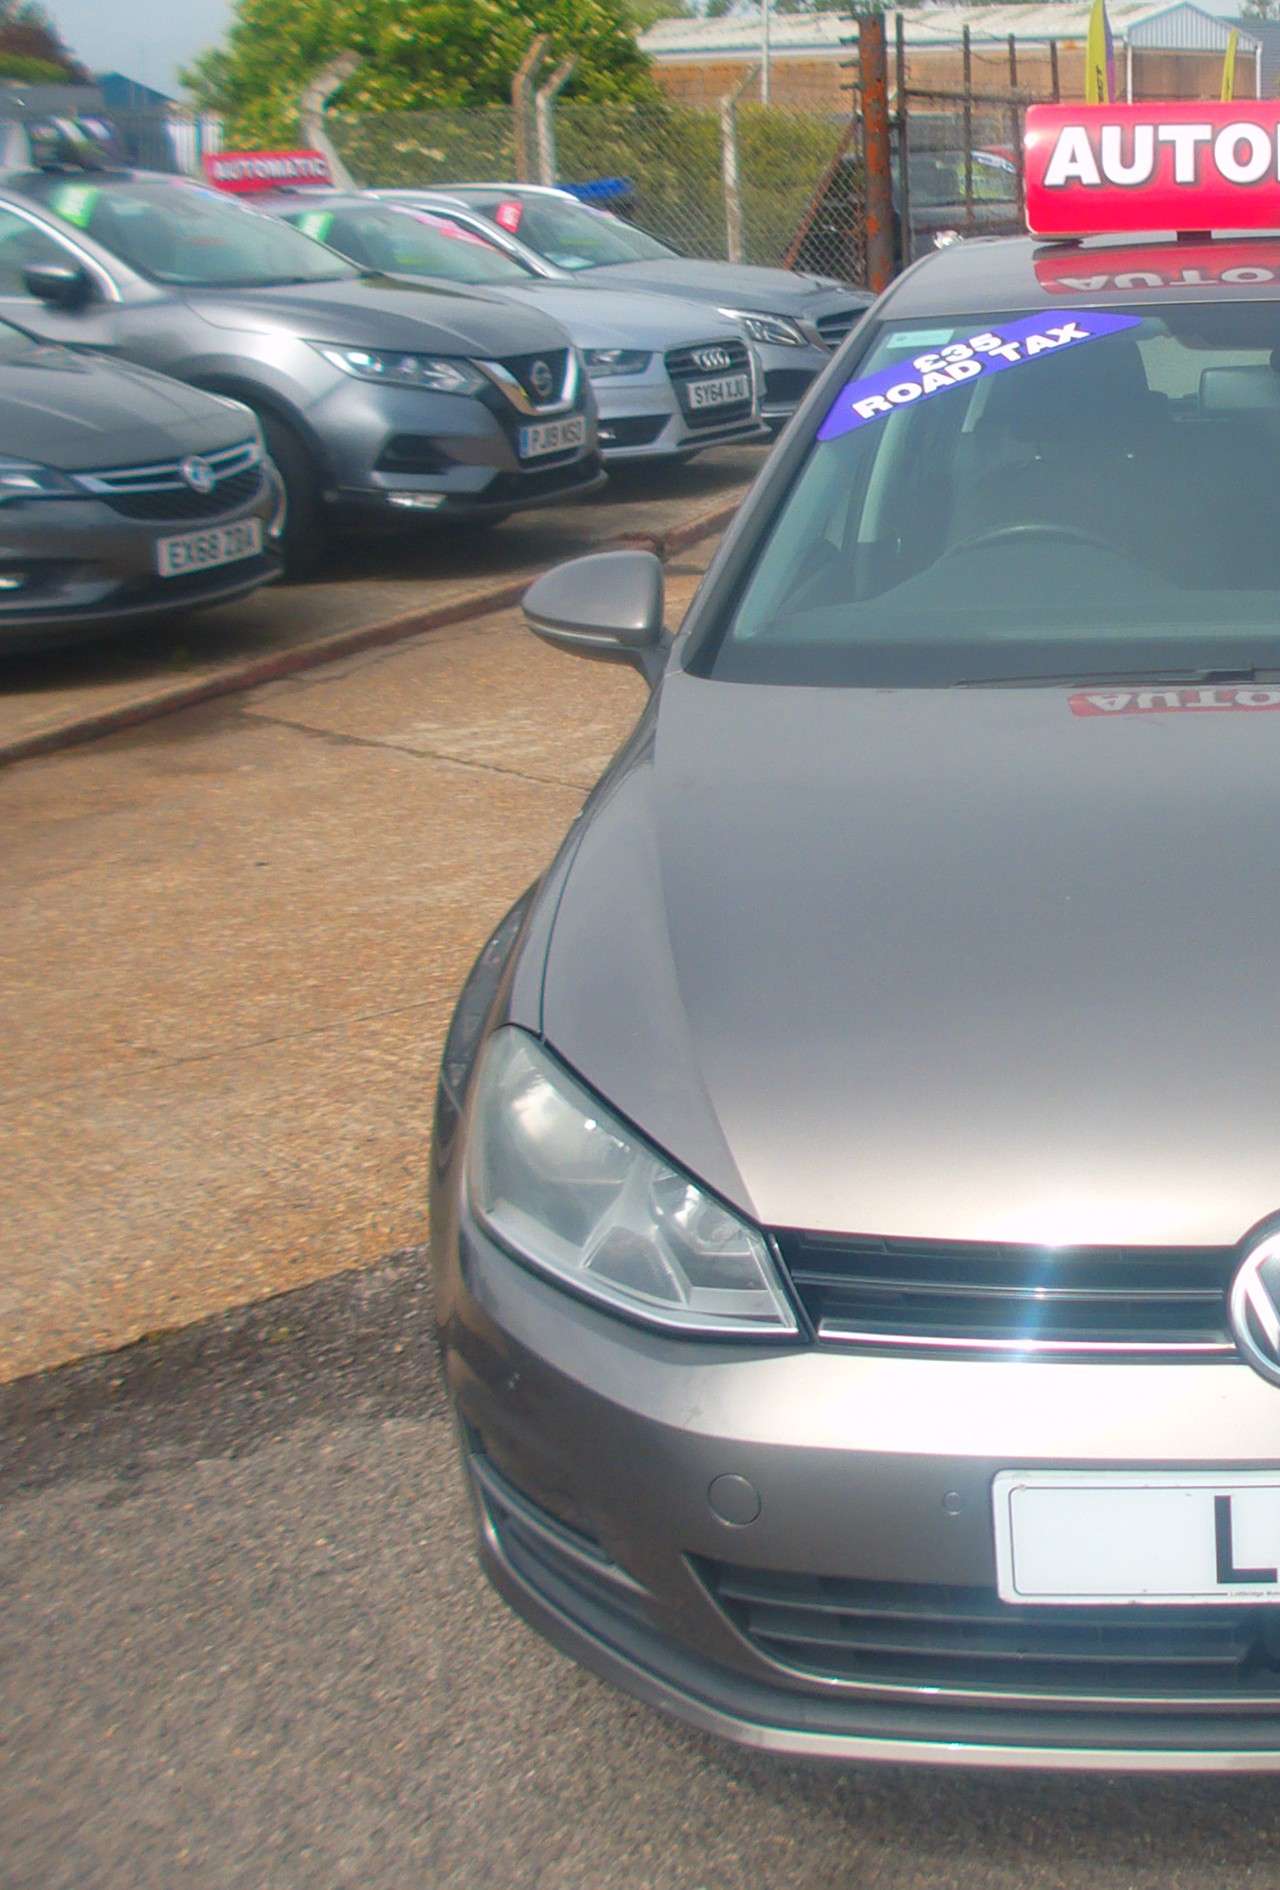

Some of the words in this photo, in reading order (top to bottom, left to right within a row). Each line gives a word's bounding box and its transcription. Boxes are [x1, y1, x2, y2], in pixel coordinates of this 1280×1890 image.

[213, 159, 329, 181] AUTOMATIC
[851, 359, 983, 420] ROAD
[988, 322, 1091, 362] TAX
[912, 332, 1003, 374] £35
